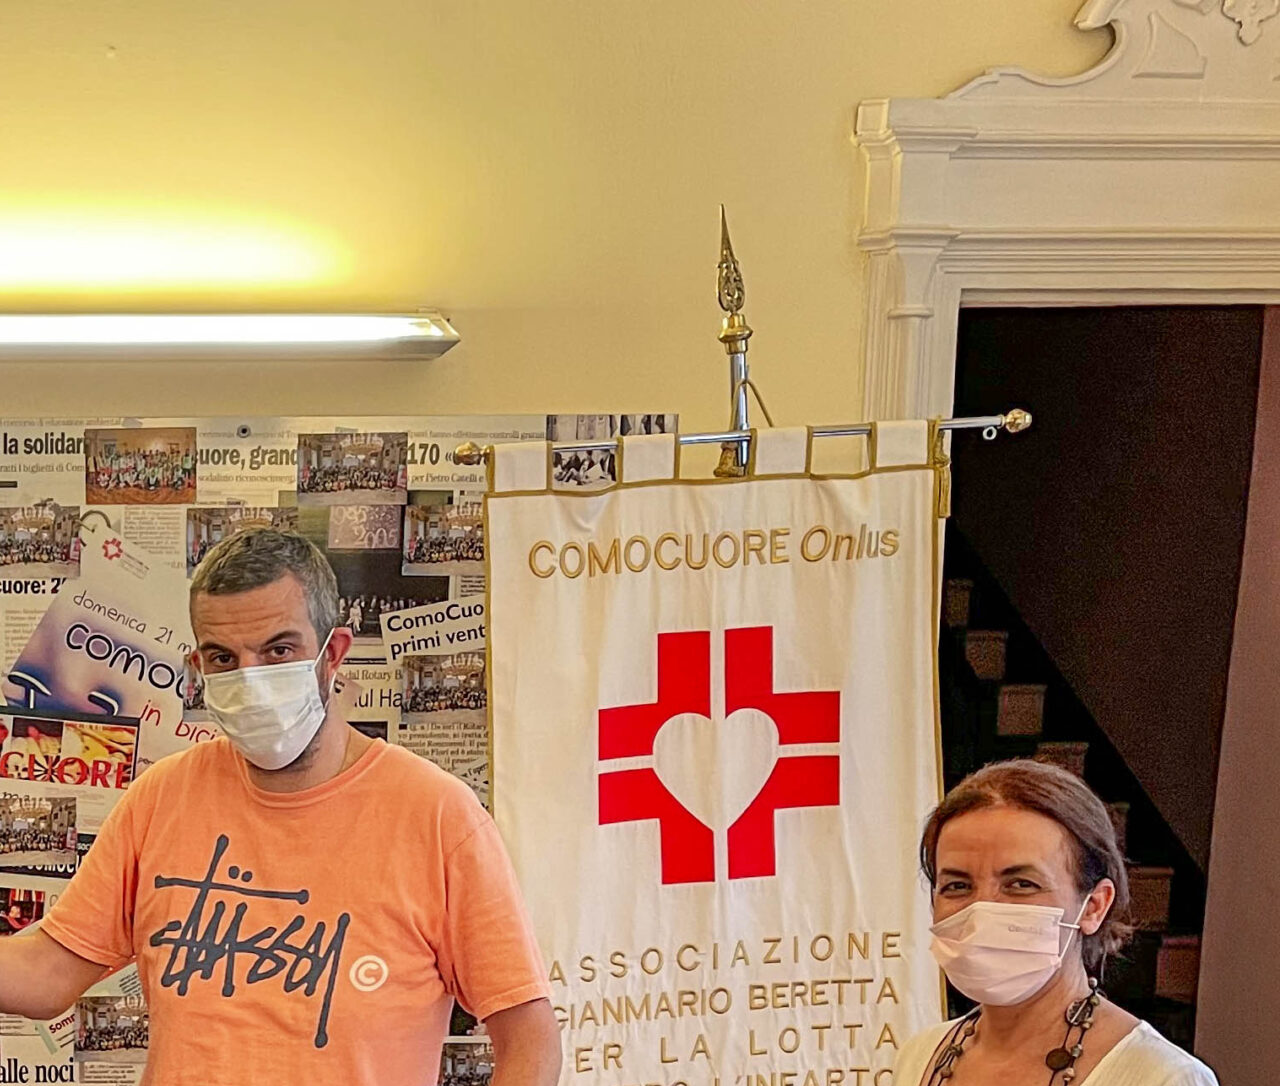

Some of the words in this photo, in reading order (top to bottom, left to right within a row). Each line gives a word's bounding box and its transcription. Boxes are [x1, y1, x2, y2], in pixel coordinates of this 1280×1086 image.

[3, 432, 18, 454] la
[23, 432, 85, 455] solidar
[408, 443, 440, 465] 170
[65, 463, 85, 473] Com
[195, 448, 246, 470] uore,
[426, 473, 450, 483] Pietro
[528, 527, 791, 580] COMOCUORE
[800, 523, 901, 563] Onlus
[73, 590, 146, 634] domenica
[154, 626, 174, 645] 21
[177, 642, 192, 653] m
[387, 603, 485, 633] ComoCuo
[390, 630, 441, 660] primi
[445, 624, 486, 644] vent
[361, 669, 392, 682] Rotary
[394, 669, 403, 680] B
[356, 689, 373, 708] ul
[379, 690, 402, 708] Ha
[140, 700, 161, 727] in
[547, 932, 902, 988] ASSOCIAZIONE
[748, 977, 900, 1012] BERETTA
[575, 1042, 624, 1074] ER
[660, 1033, 712, 1064] LA
[748, 1022, 900, 1057] LOTTA
[34, 1056, 75, 1083] noci
